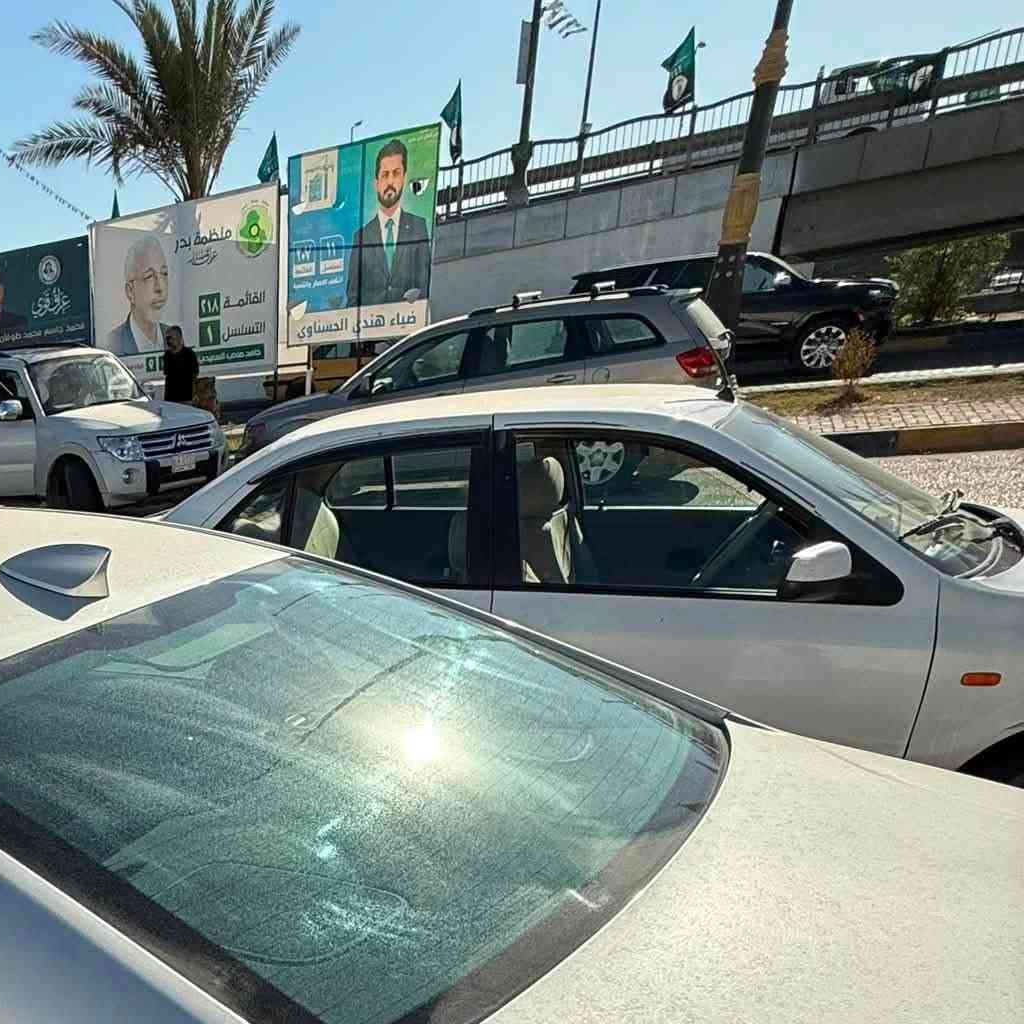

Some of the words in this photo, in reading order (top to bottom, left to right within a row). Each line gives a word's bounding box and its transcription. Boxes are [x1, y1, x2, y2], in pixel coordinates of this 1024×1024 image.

[175, 237, 191, 253] بدر
[194, 227, 232, 245] منظمة
[201, 297, 219, 314] ٢١٨
[224, 288, 266, 309] القائمة
[389, 311, 417, 329] ضياء
[223, 321, 266, 342] التسلسل
